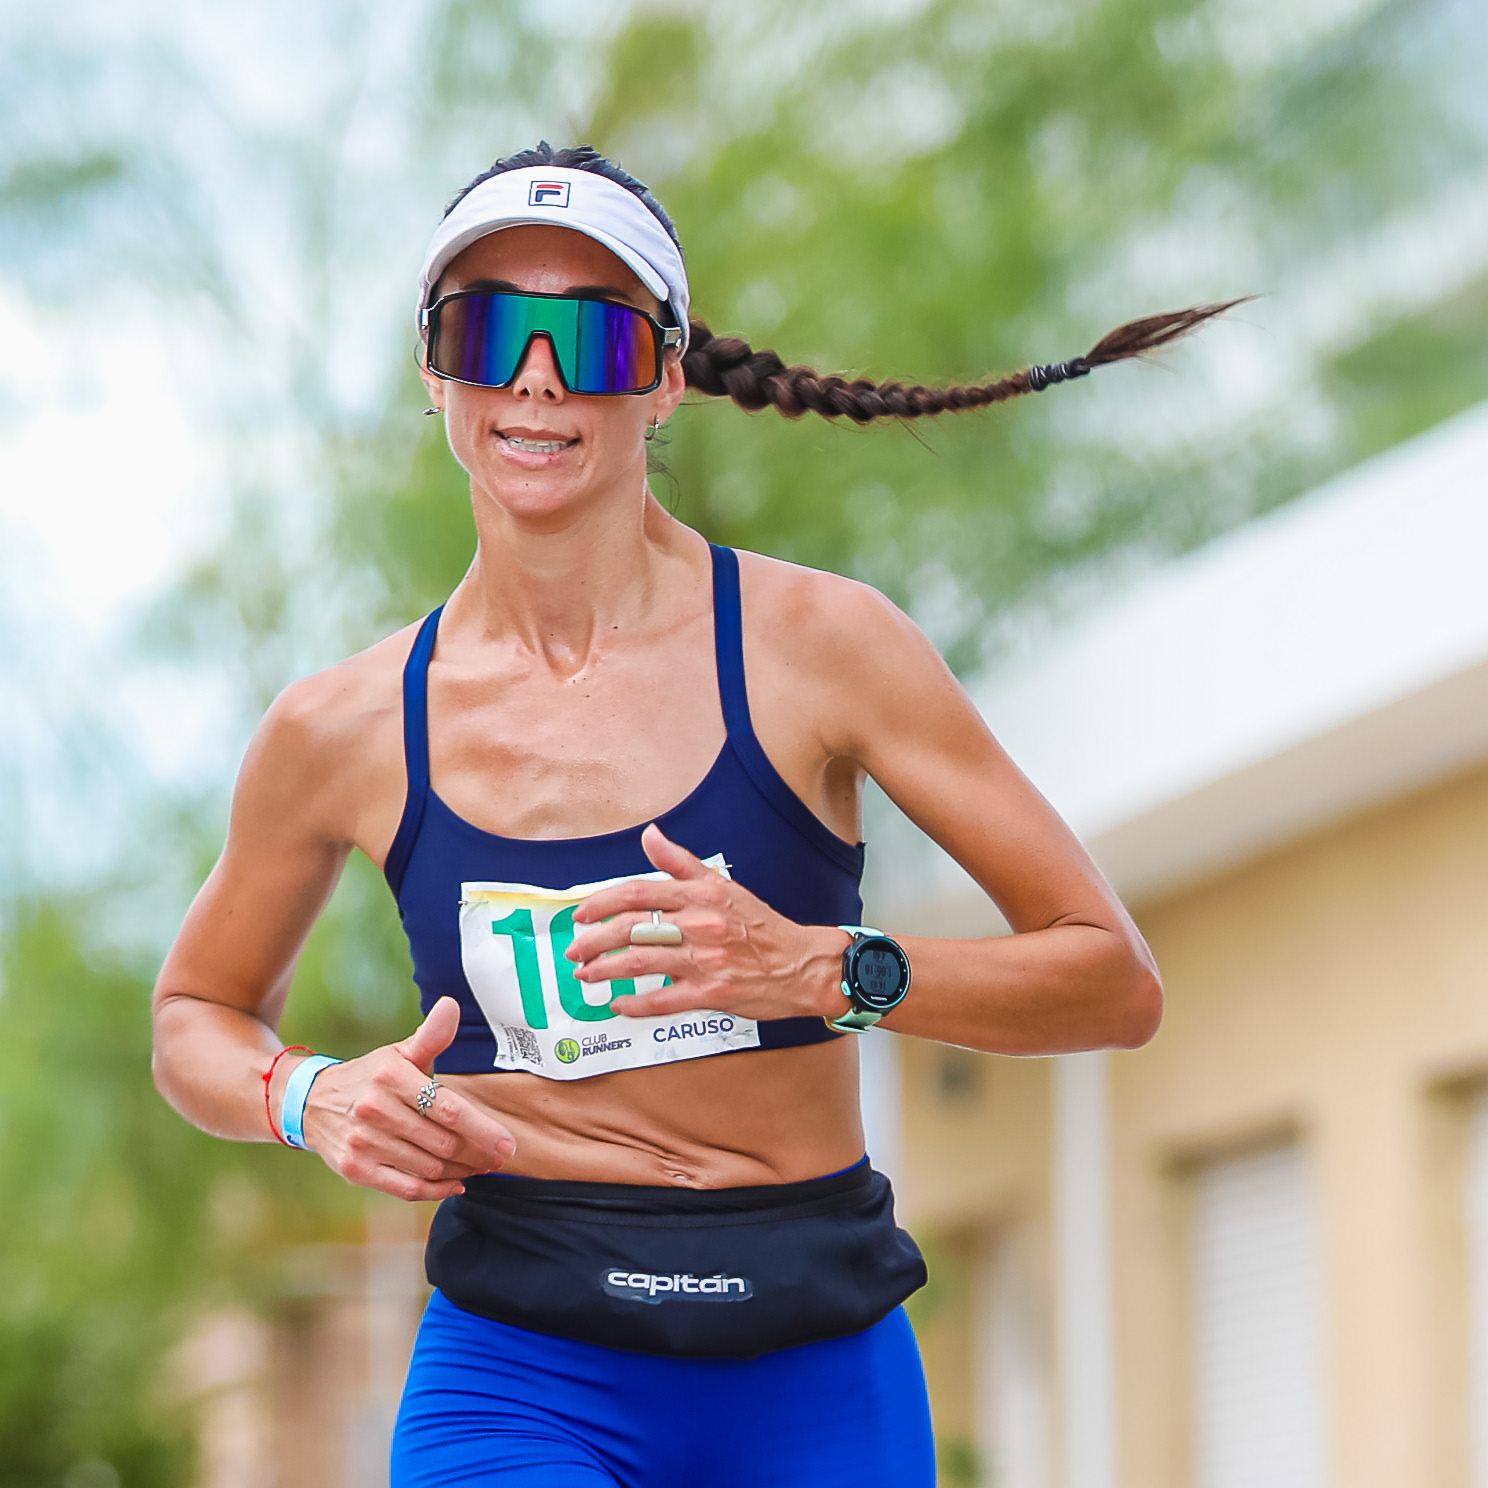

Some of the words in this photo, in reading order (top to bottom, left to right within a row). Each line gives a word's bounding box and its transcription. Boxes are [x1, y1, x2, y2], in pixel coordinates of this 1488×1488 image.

[581, 1033, 608, 1047] CLUB
[653, 1018, 734, 1043] CARUSO
[582, 1038, 632, 1057] RUNNER'S
[608, 1271, 745, 1296] capitán
